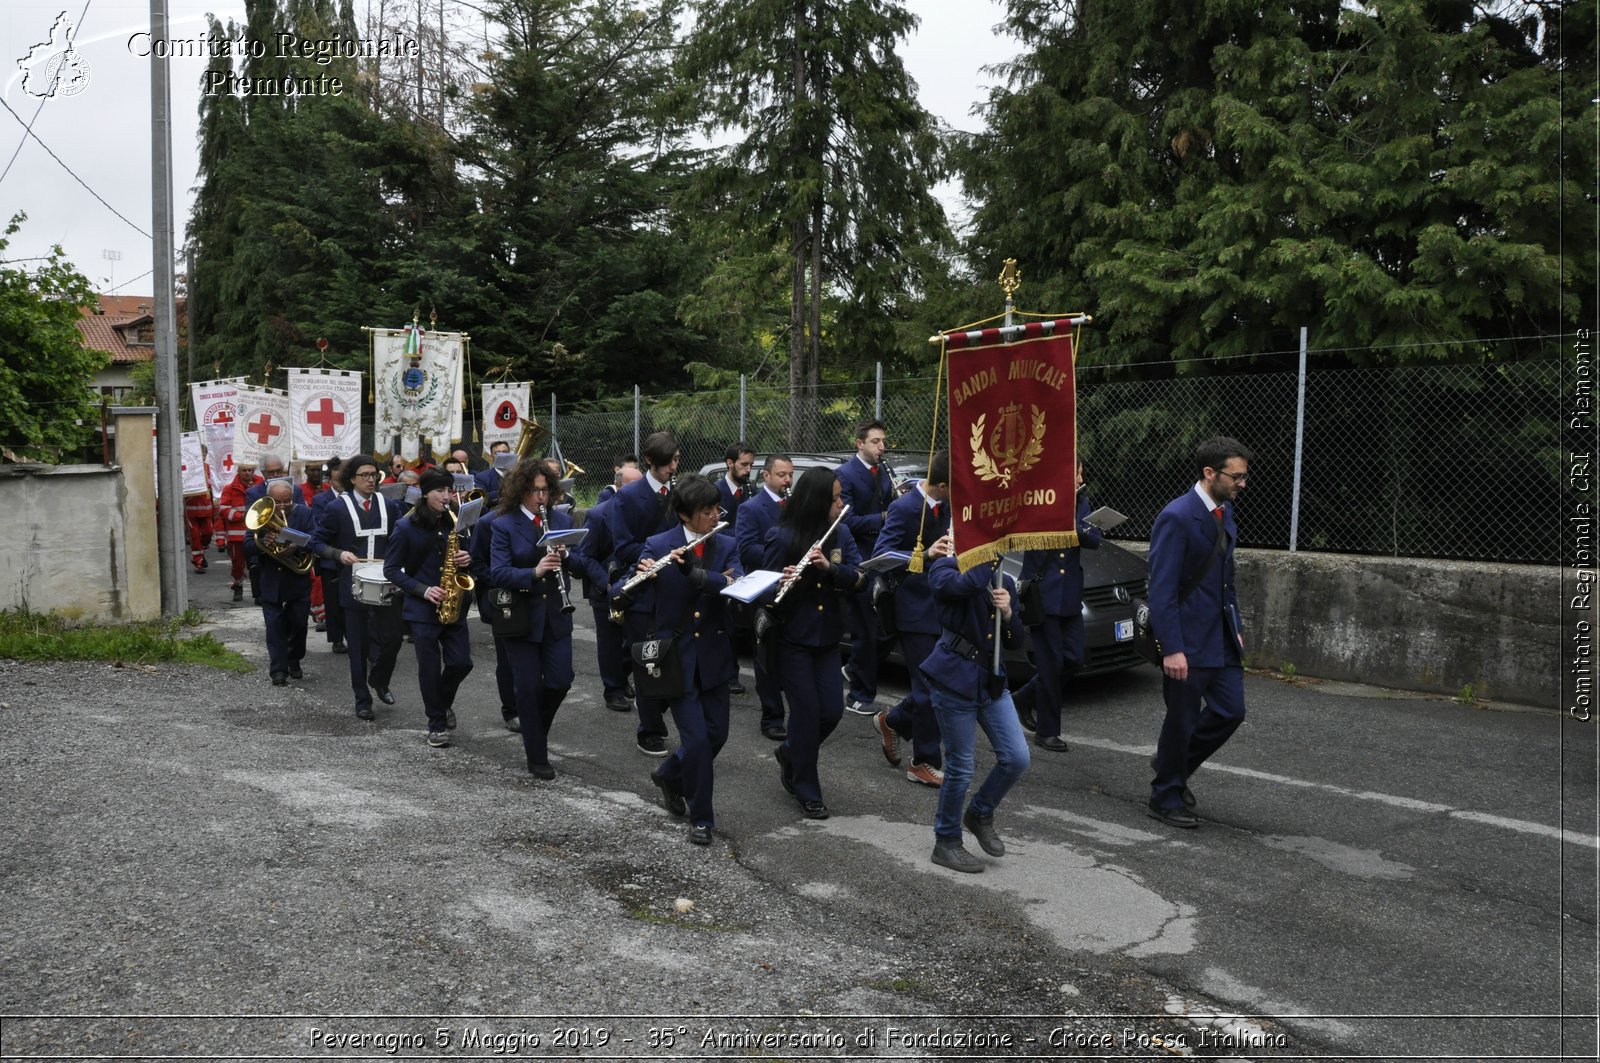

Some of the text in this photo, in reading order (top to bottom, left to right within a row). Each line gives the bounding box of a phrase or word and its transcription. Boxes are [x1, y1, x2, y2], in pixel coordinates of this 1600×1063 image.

[953, 366, 998, 407] BANDA
[962, 489, 1056, 522] DI PEVERAGNO
